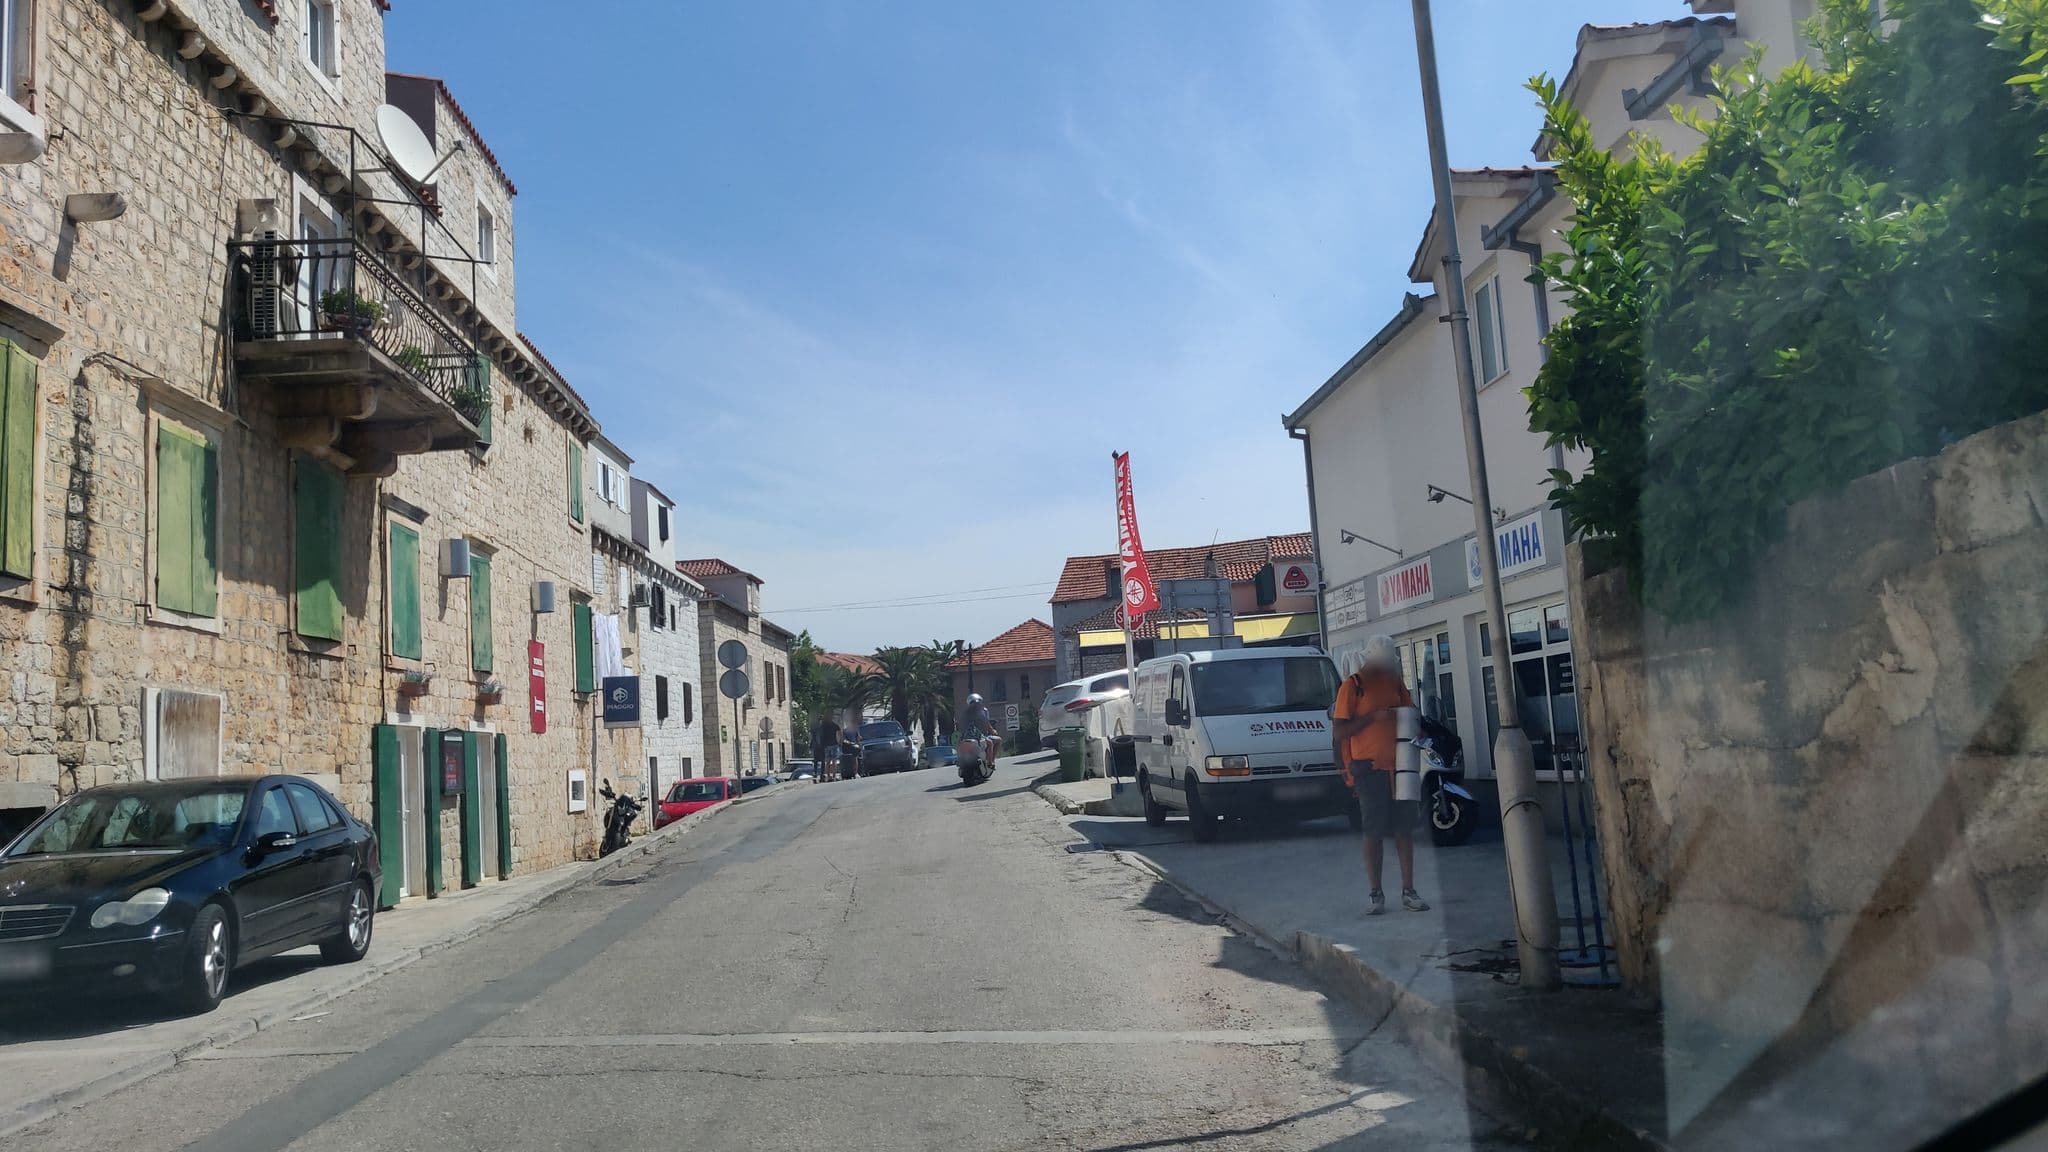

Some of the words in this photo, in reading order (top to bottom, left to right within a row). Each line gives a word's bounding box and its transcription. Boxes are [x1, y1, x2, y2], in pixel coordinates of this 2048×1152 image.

[1499, 521, 1542, 569] MAHA
[1389, 562, 1431, 604] YAMAHA
[1117, 611, 1142, 623] SOP
[1265, 720, 1325, 731] YAMAHA
